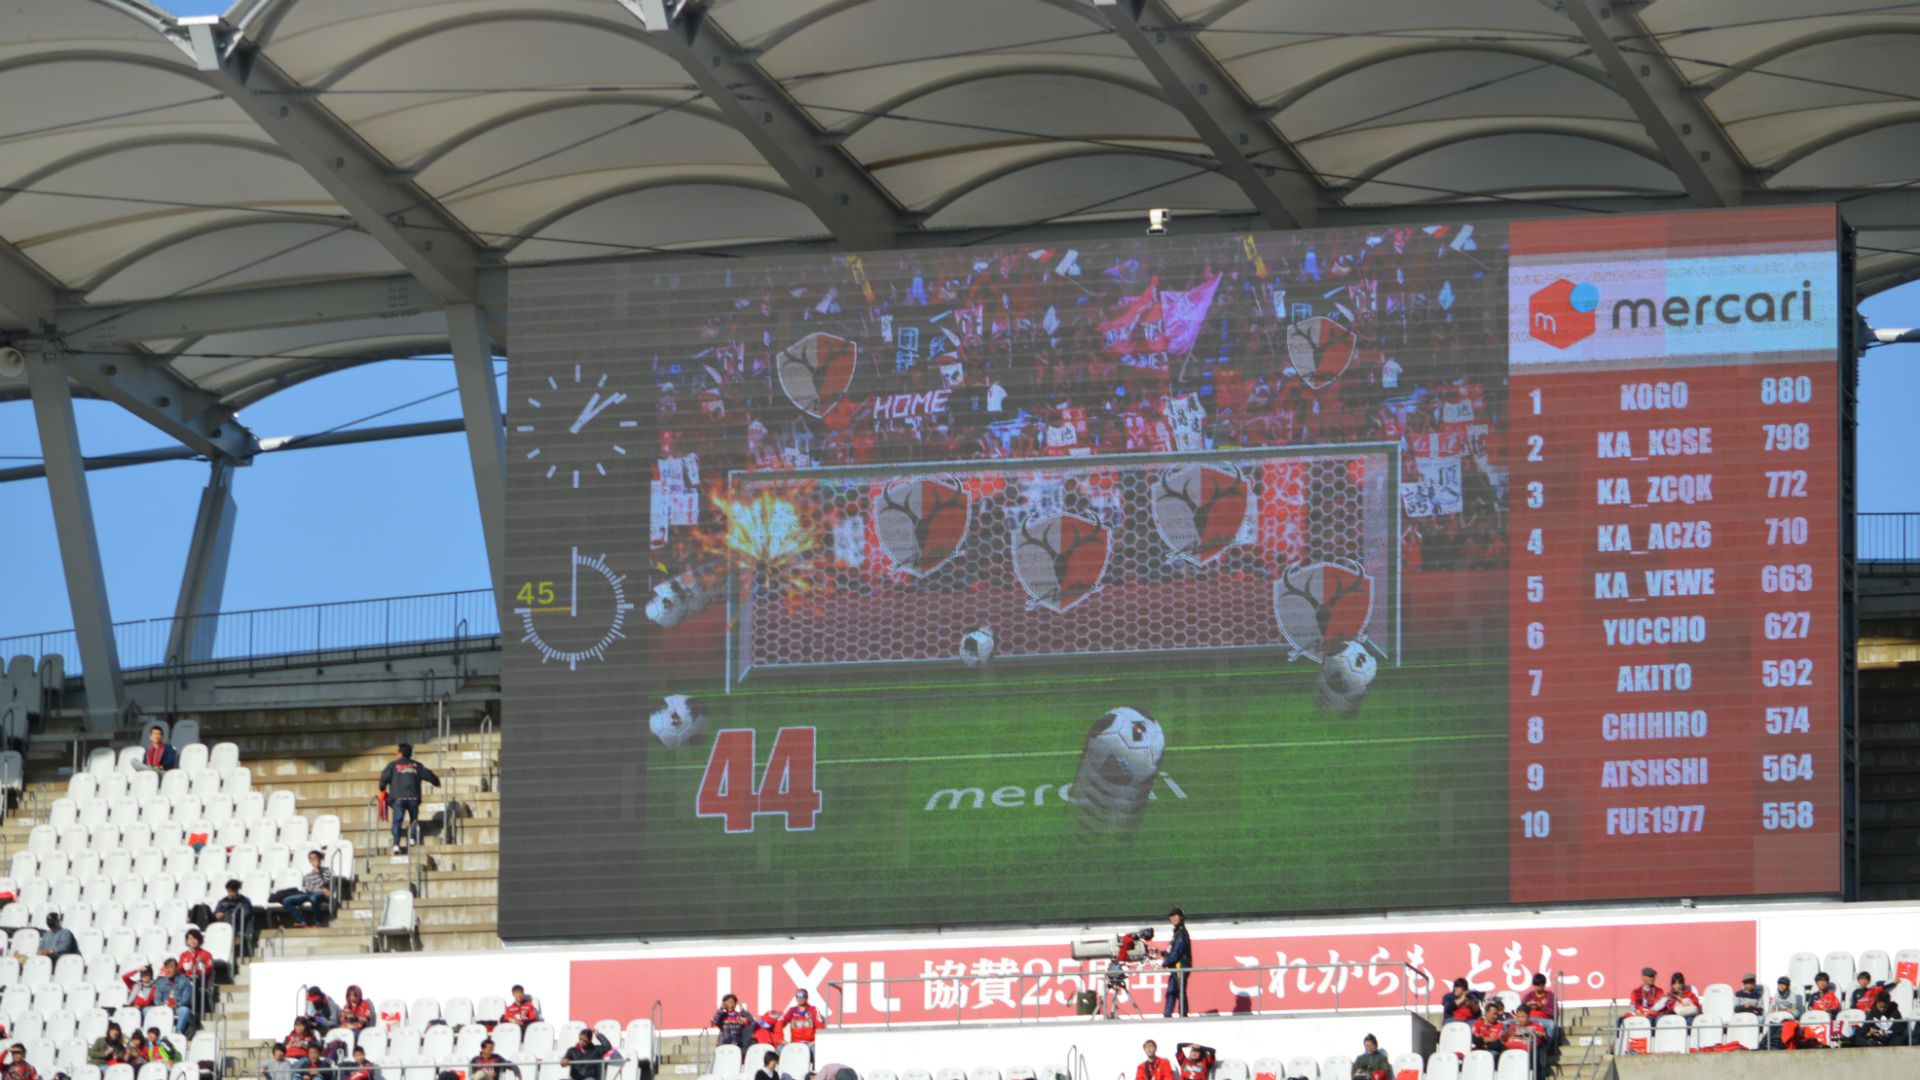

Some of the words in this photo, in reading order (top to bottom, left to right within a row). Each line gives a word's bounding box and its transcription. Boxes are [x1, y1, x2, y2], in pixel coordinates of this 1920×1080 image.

[1535, 312, 1556, 336] m
[1612, 279, 1812, 330] mercari
[873, 389, 952, 419] HOME
[1528, 388, 1542, 415] 1
[1620, 381, 1689, 411] KOGO
[1760, 375, 1812, 405] 880
[1527, 434, 1544, 462] 2
[1597, 427, 1713, 461] KA_K9SE
[1762, 422, 1810, 451] 798
[1527, 481, 1544, 509] 3
[1597, 474, 1713, 508] KA_ZCQK
[1765, 470, 1808, 498] 772
[1527, 528, 1544, 555] 4
[1597, 520, 1712, 555] KA_ACZ6
[1765, 516, 1808, 545] 710
[516, 581, 555, 605] 45
[1527, 575, 1544, 602] 5
[1594, 568, 1715, 601] KA_VEWE
[1761, 564, 1813, 593] 663
[1526, 621, 1545, 650] 6
[1603, 615, 1706, 646] YUCCHO
[1764, 611, 1811, 640] 627
[1528, 669, 1543, 696] 7
[1617, 663, 1692, 693] AKITO
[1762, 658, 1813, 687] 592
[1527, 716, 1544, 744] 8
[1602, 709, 1708, 741] CHIHIRO
[1765, 706, 1811, 735] 574
[696, 726, 823, 834] 44
[924, 771, 1188, 811] merci
[1527, 763, 1544, 791] 9
[1601, 757, 1709, 788] ATSHSHI
[1762, 753, 1813, 782] 564
[1521, 810, 1550, 838] 10
[1606, 805, 1705, 835] FUE1977
[1762, 800, 1814, 830] 558
[716, 956, 901, 1017] LIXIL
[1228, 940, 1605, 999] これからも、ともに。
